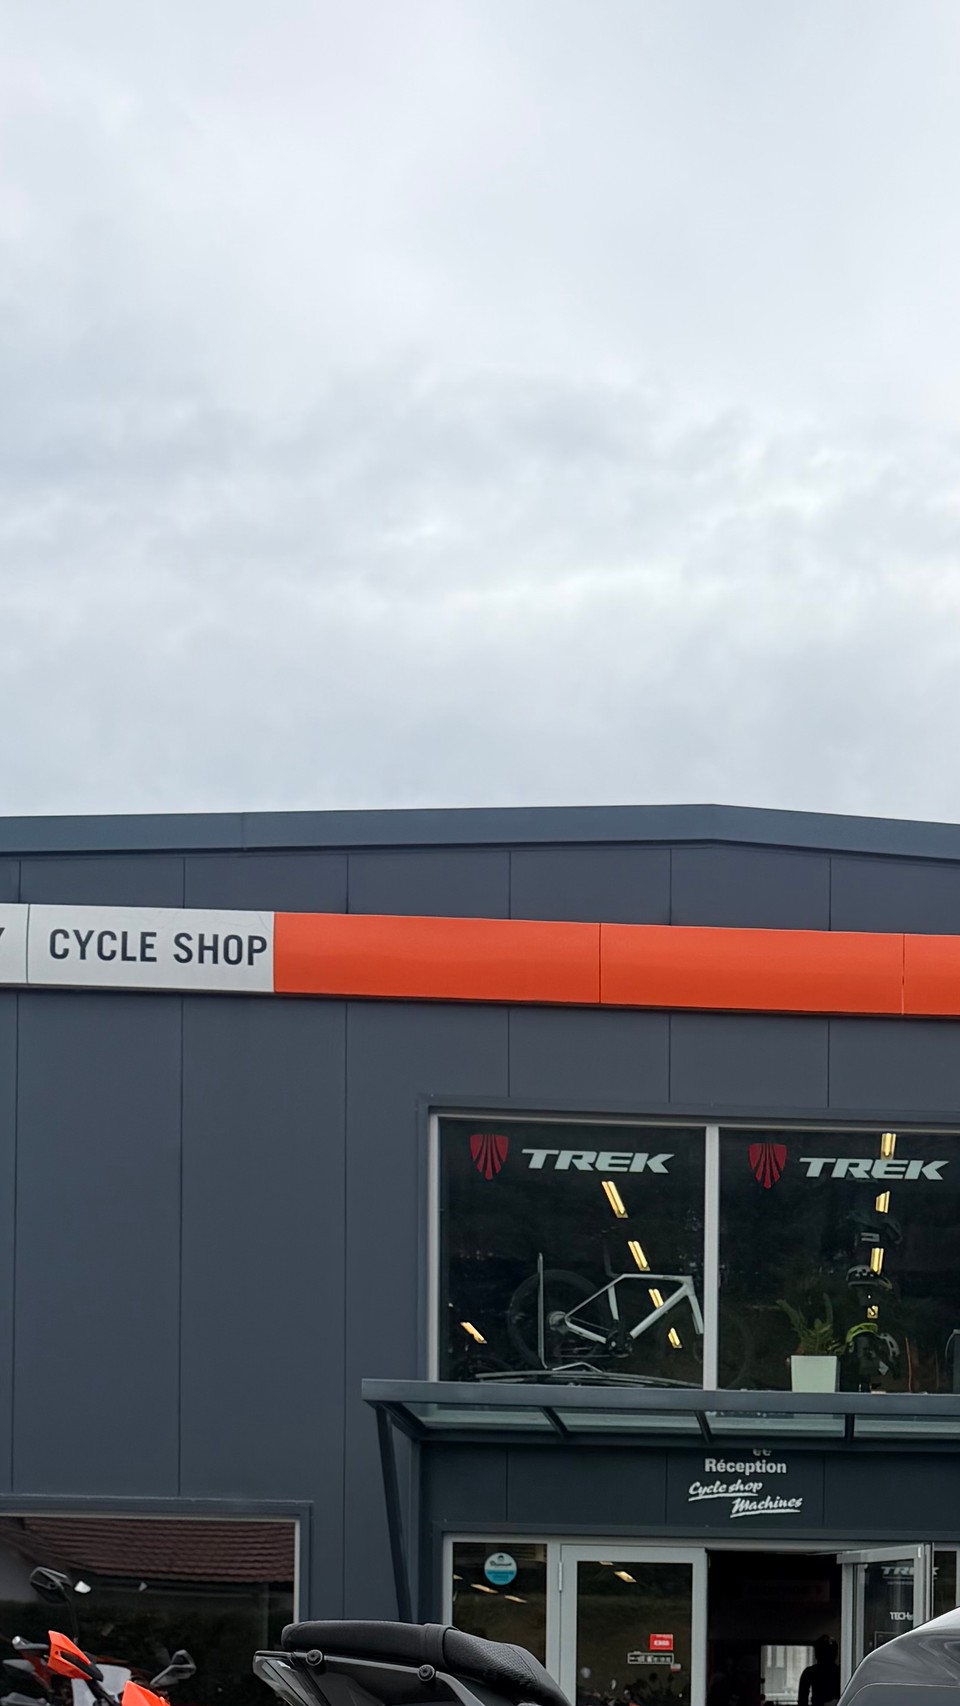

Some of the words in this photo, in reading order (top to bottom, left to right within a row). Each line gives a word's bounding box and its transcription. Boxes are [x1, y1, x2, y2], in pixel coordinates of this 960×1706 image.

[49, 928, 158, 963] CYCLE
[173, 932, 268, 966] SHOP
[521, 1148, 676, 1174] TREK
[799, 1157, 950, 1181] TREK
[704, 1458, 787, 1476] Réception
[688, 1480, 727, 1498] Cycle
[728, 1479, 763, 1493] shop
[731, 1495, 803, 1514] Machines
